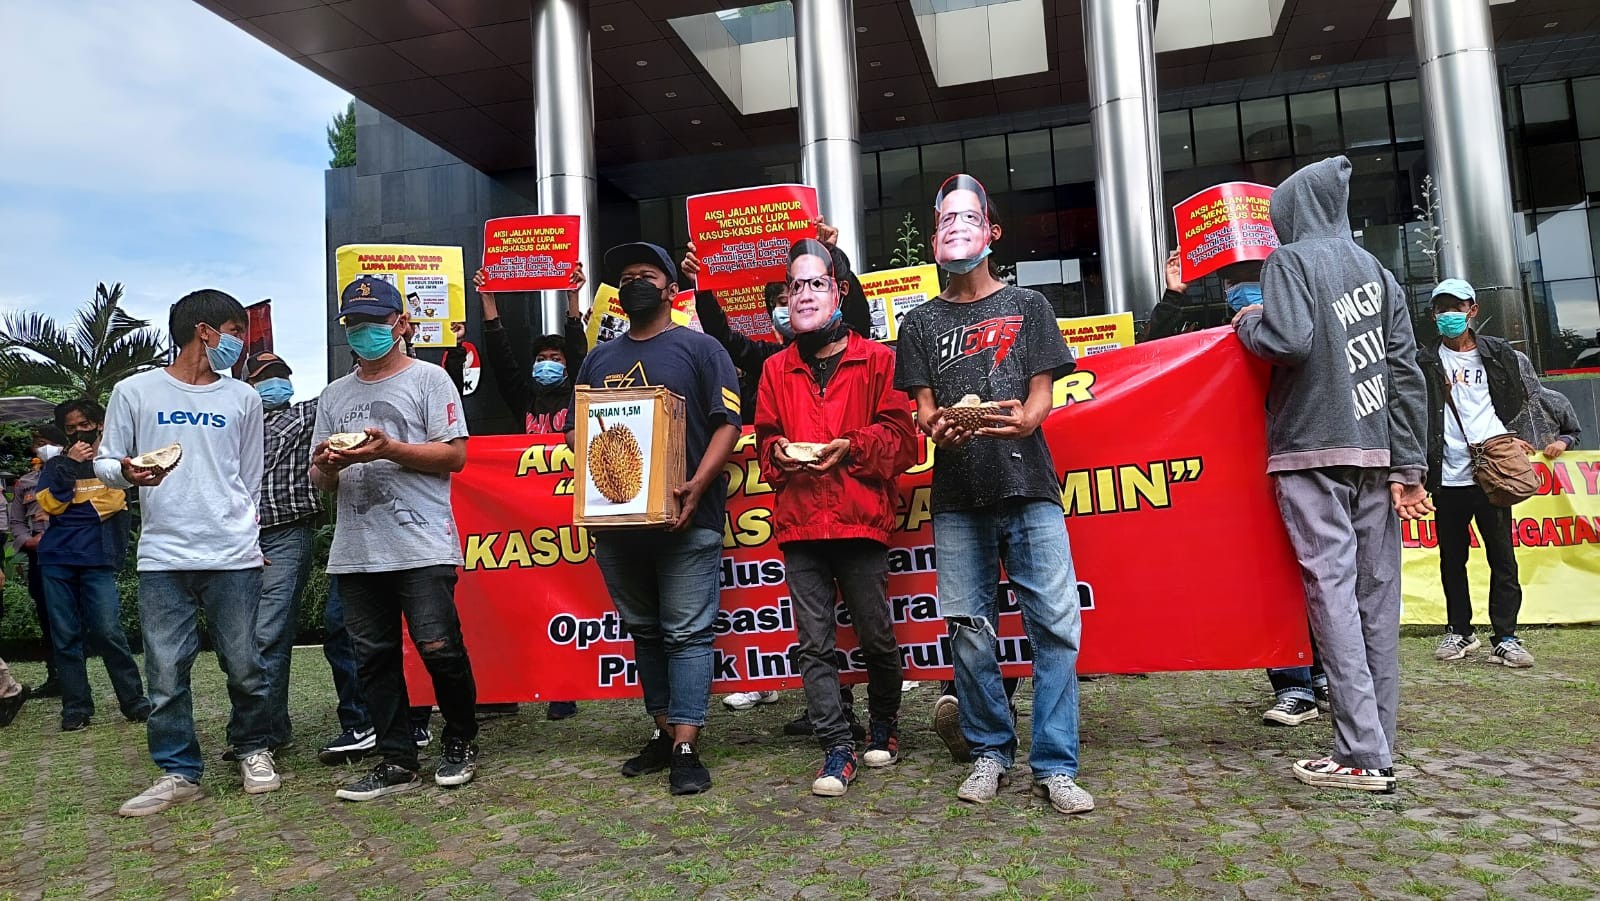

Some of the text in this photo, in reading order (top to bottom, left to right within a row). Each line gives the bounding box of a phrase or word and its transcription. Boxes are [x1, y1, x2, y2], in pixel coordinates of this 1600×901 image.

[705, 201, 801, 221] AKSI JALAN MUNDUR
[1190, 196, 1270, 219] AKSI JALAN MUND
[765, 212, 789, 223] LUPA
[699, 227, 763, 241] KASUS-KASUS
[765, 223, 784, 233] CAK
[1185, 212, 1269, 239] KASUS-KASUS CAK
[493, 227, 565, 239] AKSI JALAN MUNDUR
[487, 244, 534, 253] KASUS-KASUS
[722, 242, 755, 253] kardus
[702, 250, 756, 265] optimalisasi
[362, 263, 386, 271] LUPA
[709, 260, 743, 275] proyek
[731, 287, 750, 296] JALAN
[588, 405, 641, 418] DURIAN 1,5M
